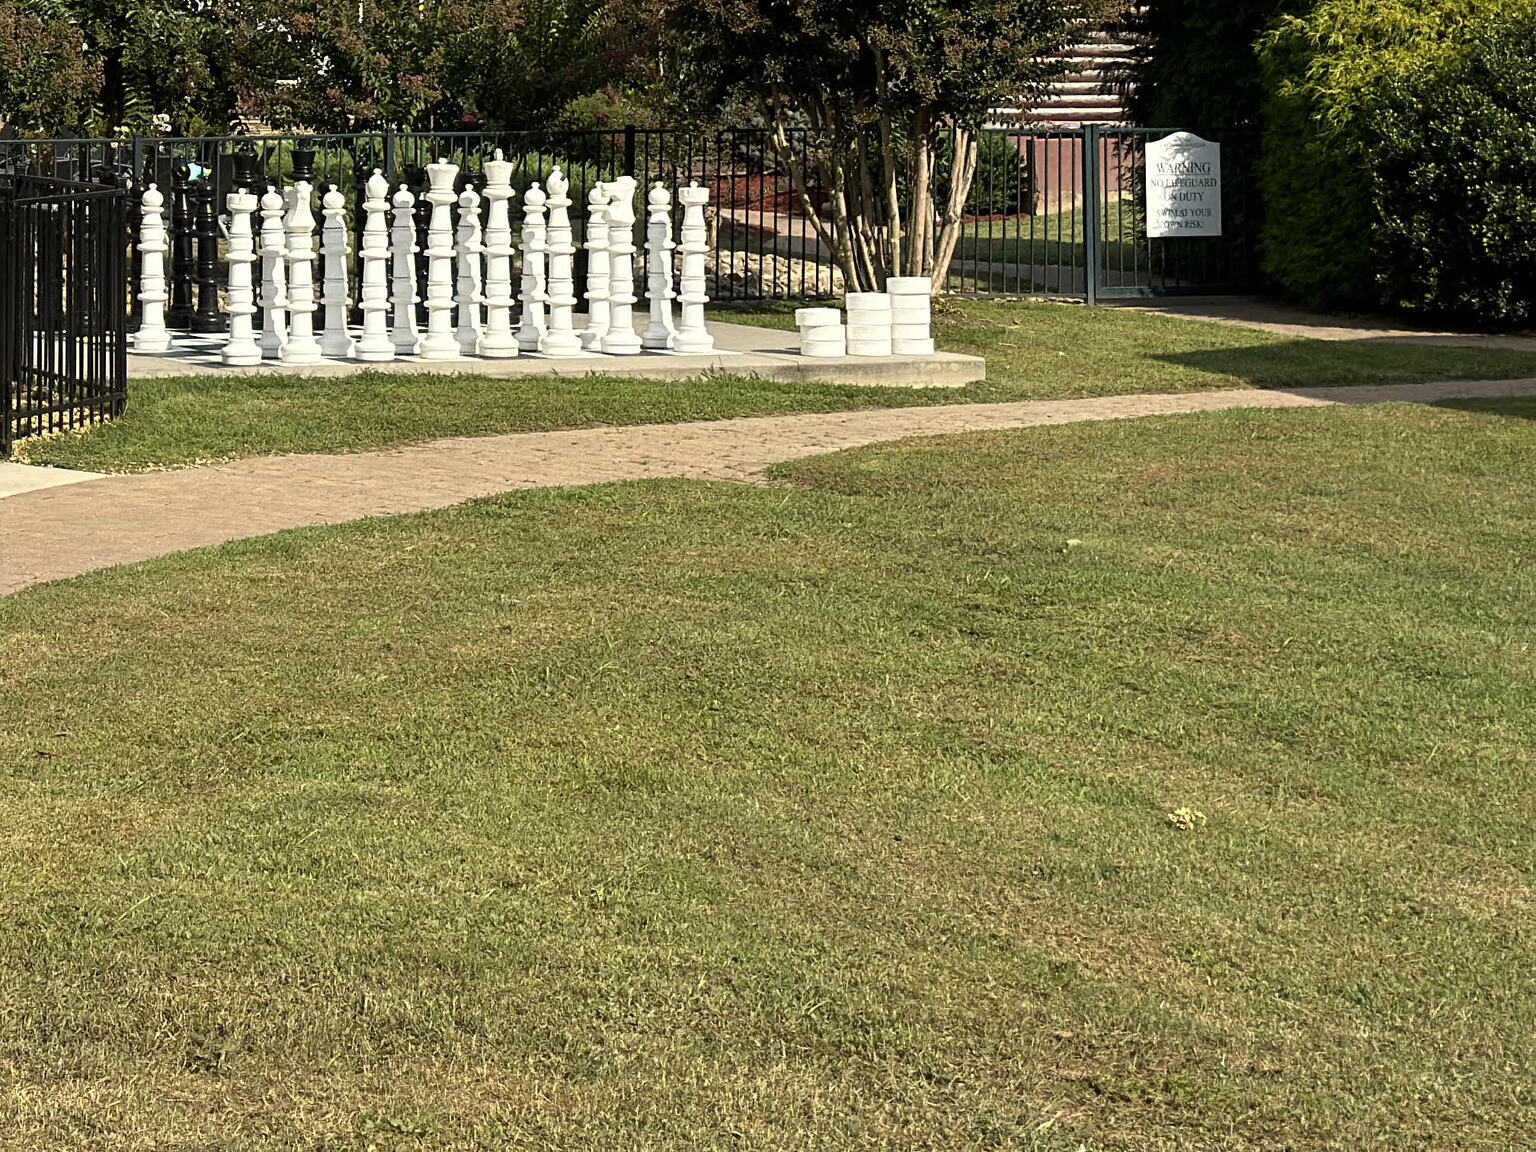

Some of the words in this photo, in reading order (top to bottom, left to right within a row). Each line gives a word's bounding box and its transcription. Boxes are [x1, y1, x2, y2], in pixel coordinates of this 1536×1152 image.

[1156, 162, 1211, 175] WARNING
[1151, 179, 1164, 188] NO
[1165, 178, 1217, 188] LIFEGUARD
[1179, 191, 1204, 202] DUTY
[1190, 208, 1212, 217] YOUR
